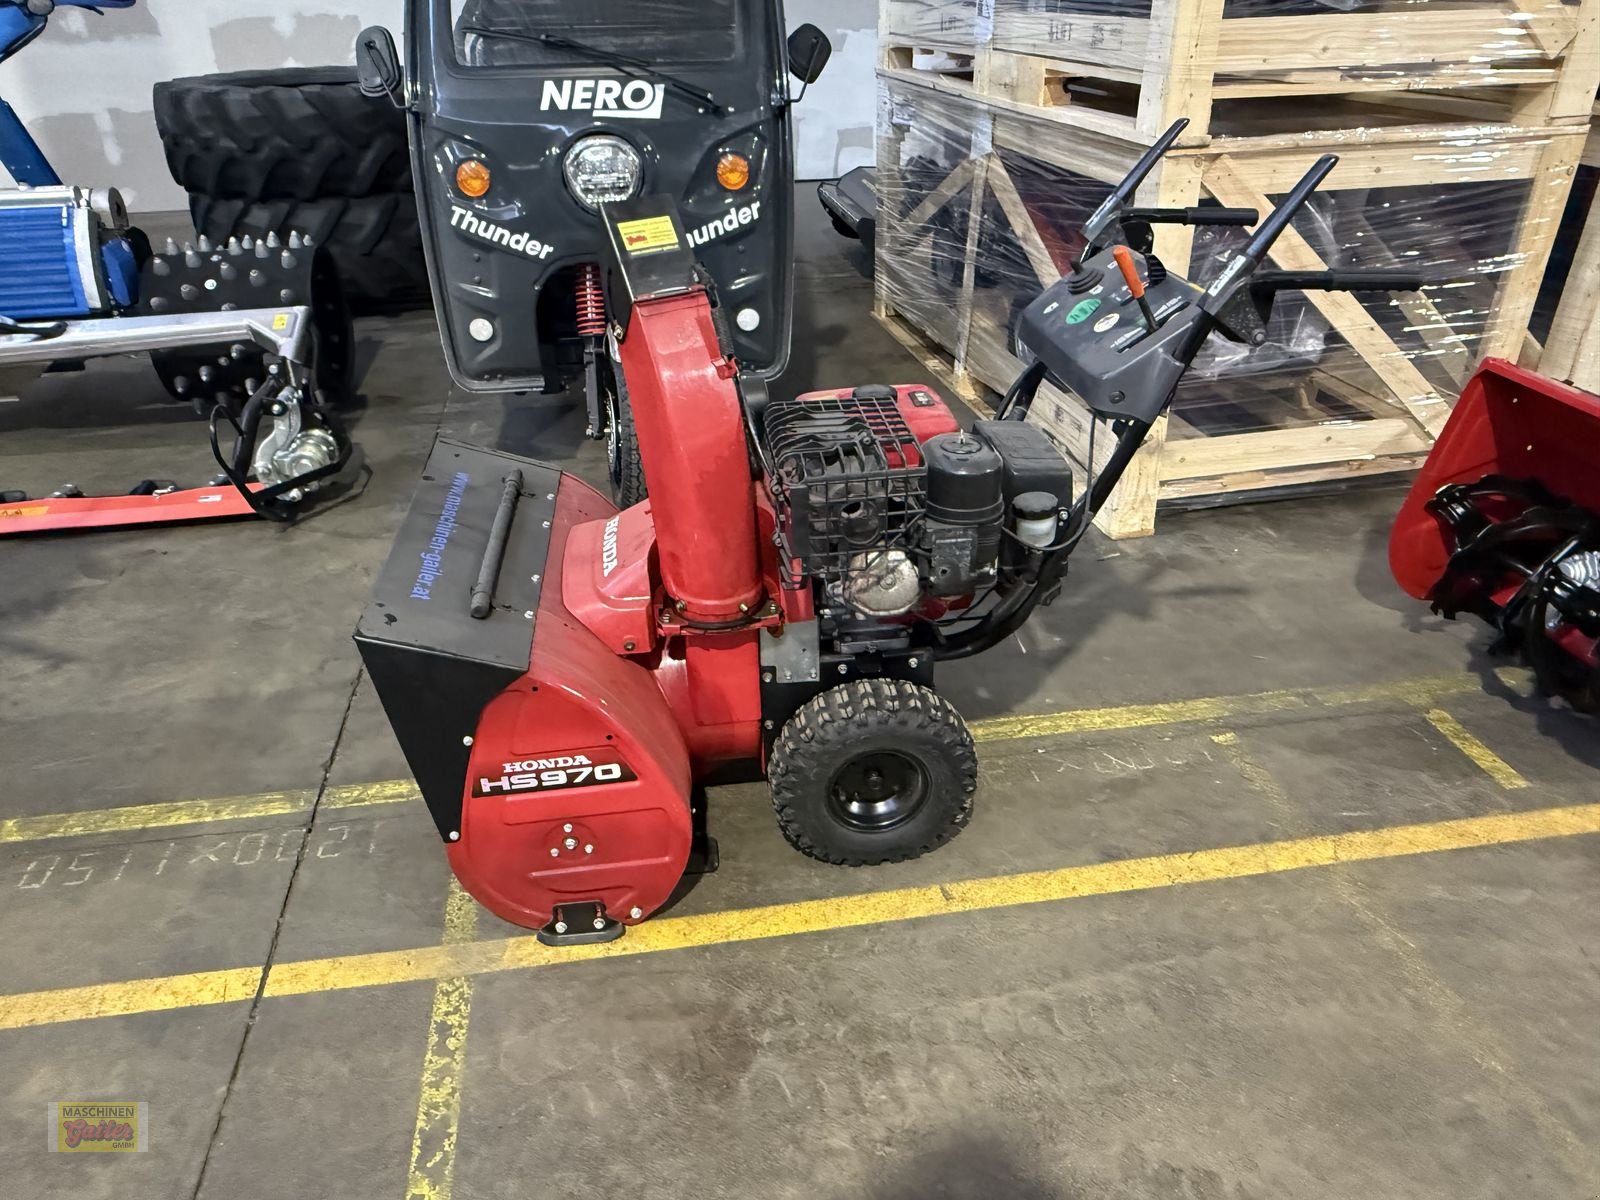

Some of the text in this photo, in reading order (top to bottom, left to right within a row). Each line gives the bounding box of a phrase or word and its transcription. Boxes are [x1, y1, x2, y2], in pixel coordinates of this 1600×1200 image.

[540, 80, 654, 110] NERO
[450, 205, 554, 259] Thunder
[686, 200, 760, 248] under
[603, 515, 620, 577] HONDA
[479, 763, 622, 793] HS970
[501, 755, 593, 774] HONDA
